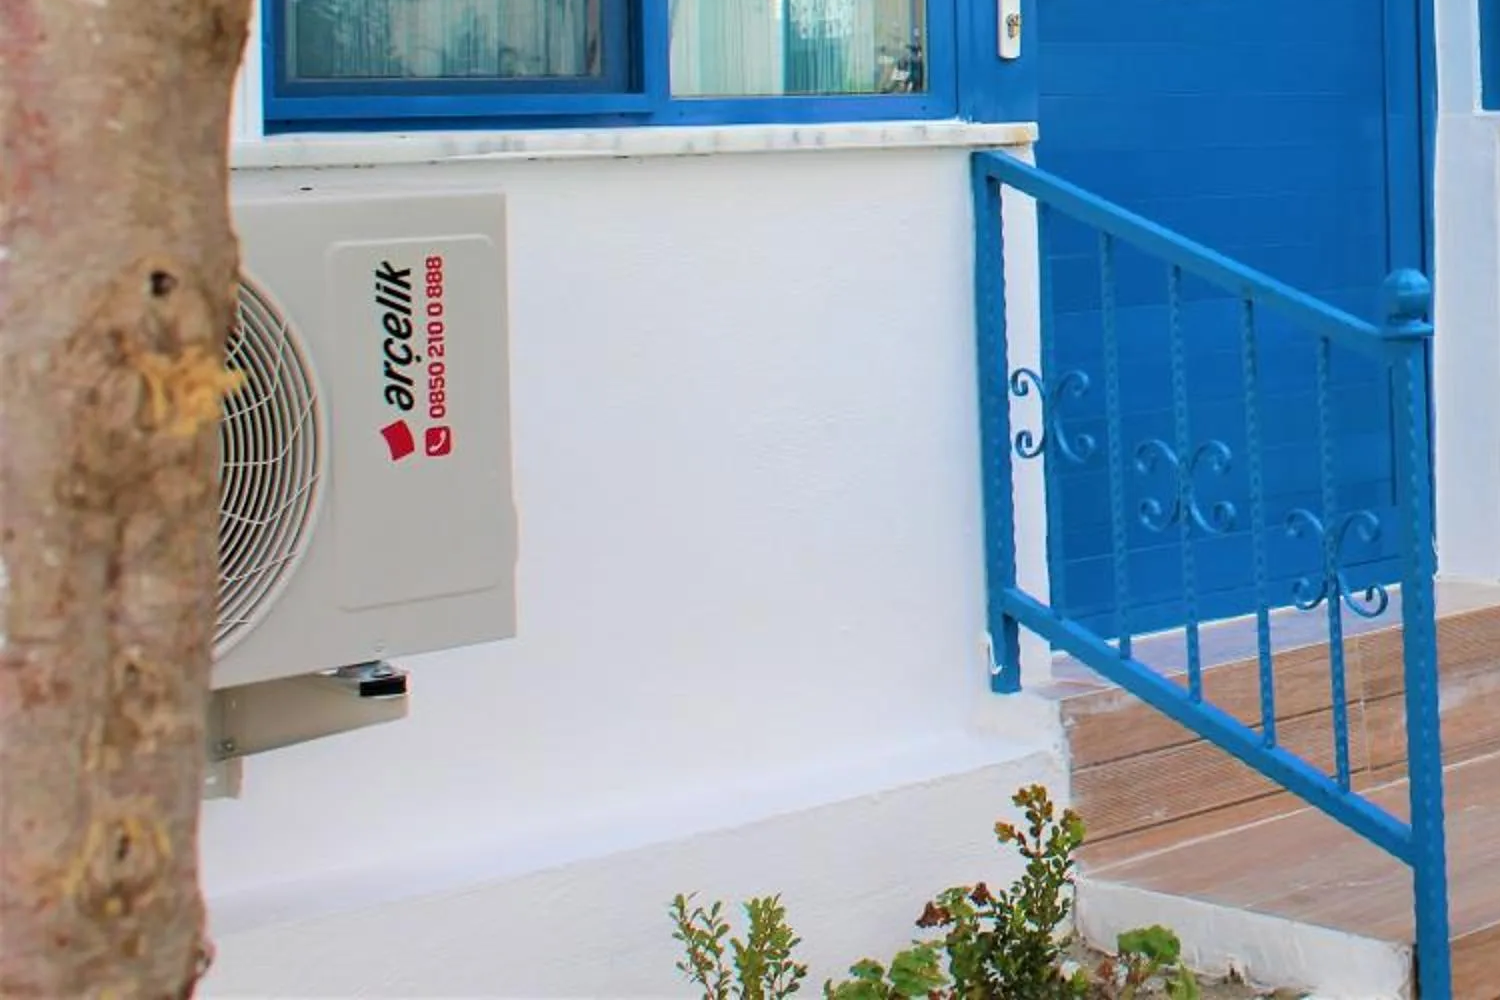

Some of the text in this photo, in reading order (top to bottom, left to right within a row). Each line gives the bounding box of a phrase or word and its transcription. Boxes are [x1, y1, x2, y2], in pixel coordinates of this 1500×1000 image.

[375, 260, 421, 411] arçelik
[426, 256, 446, 418] 0850 210 0 888
